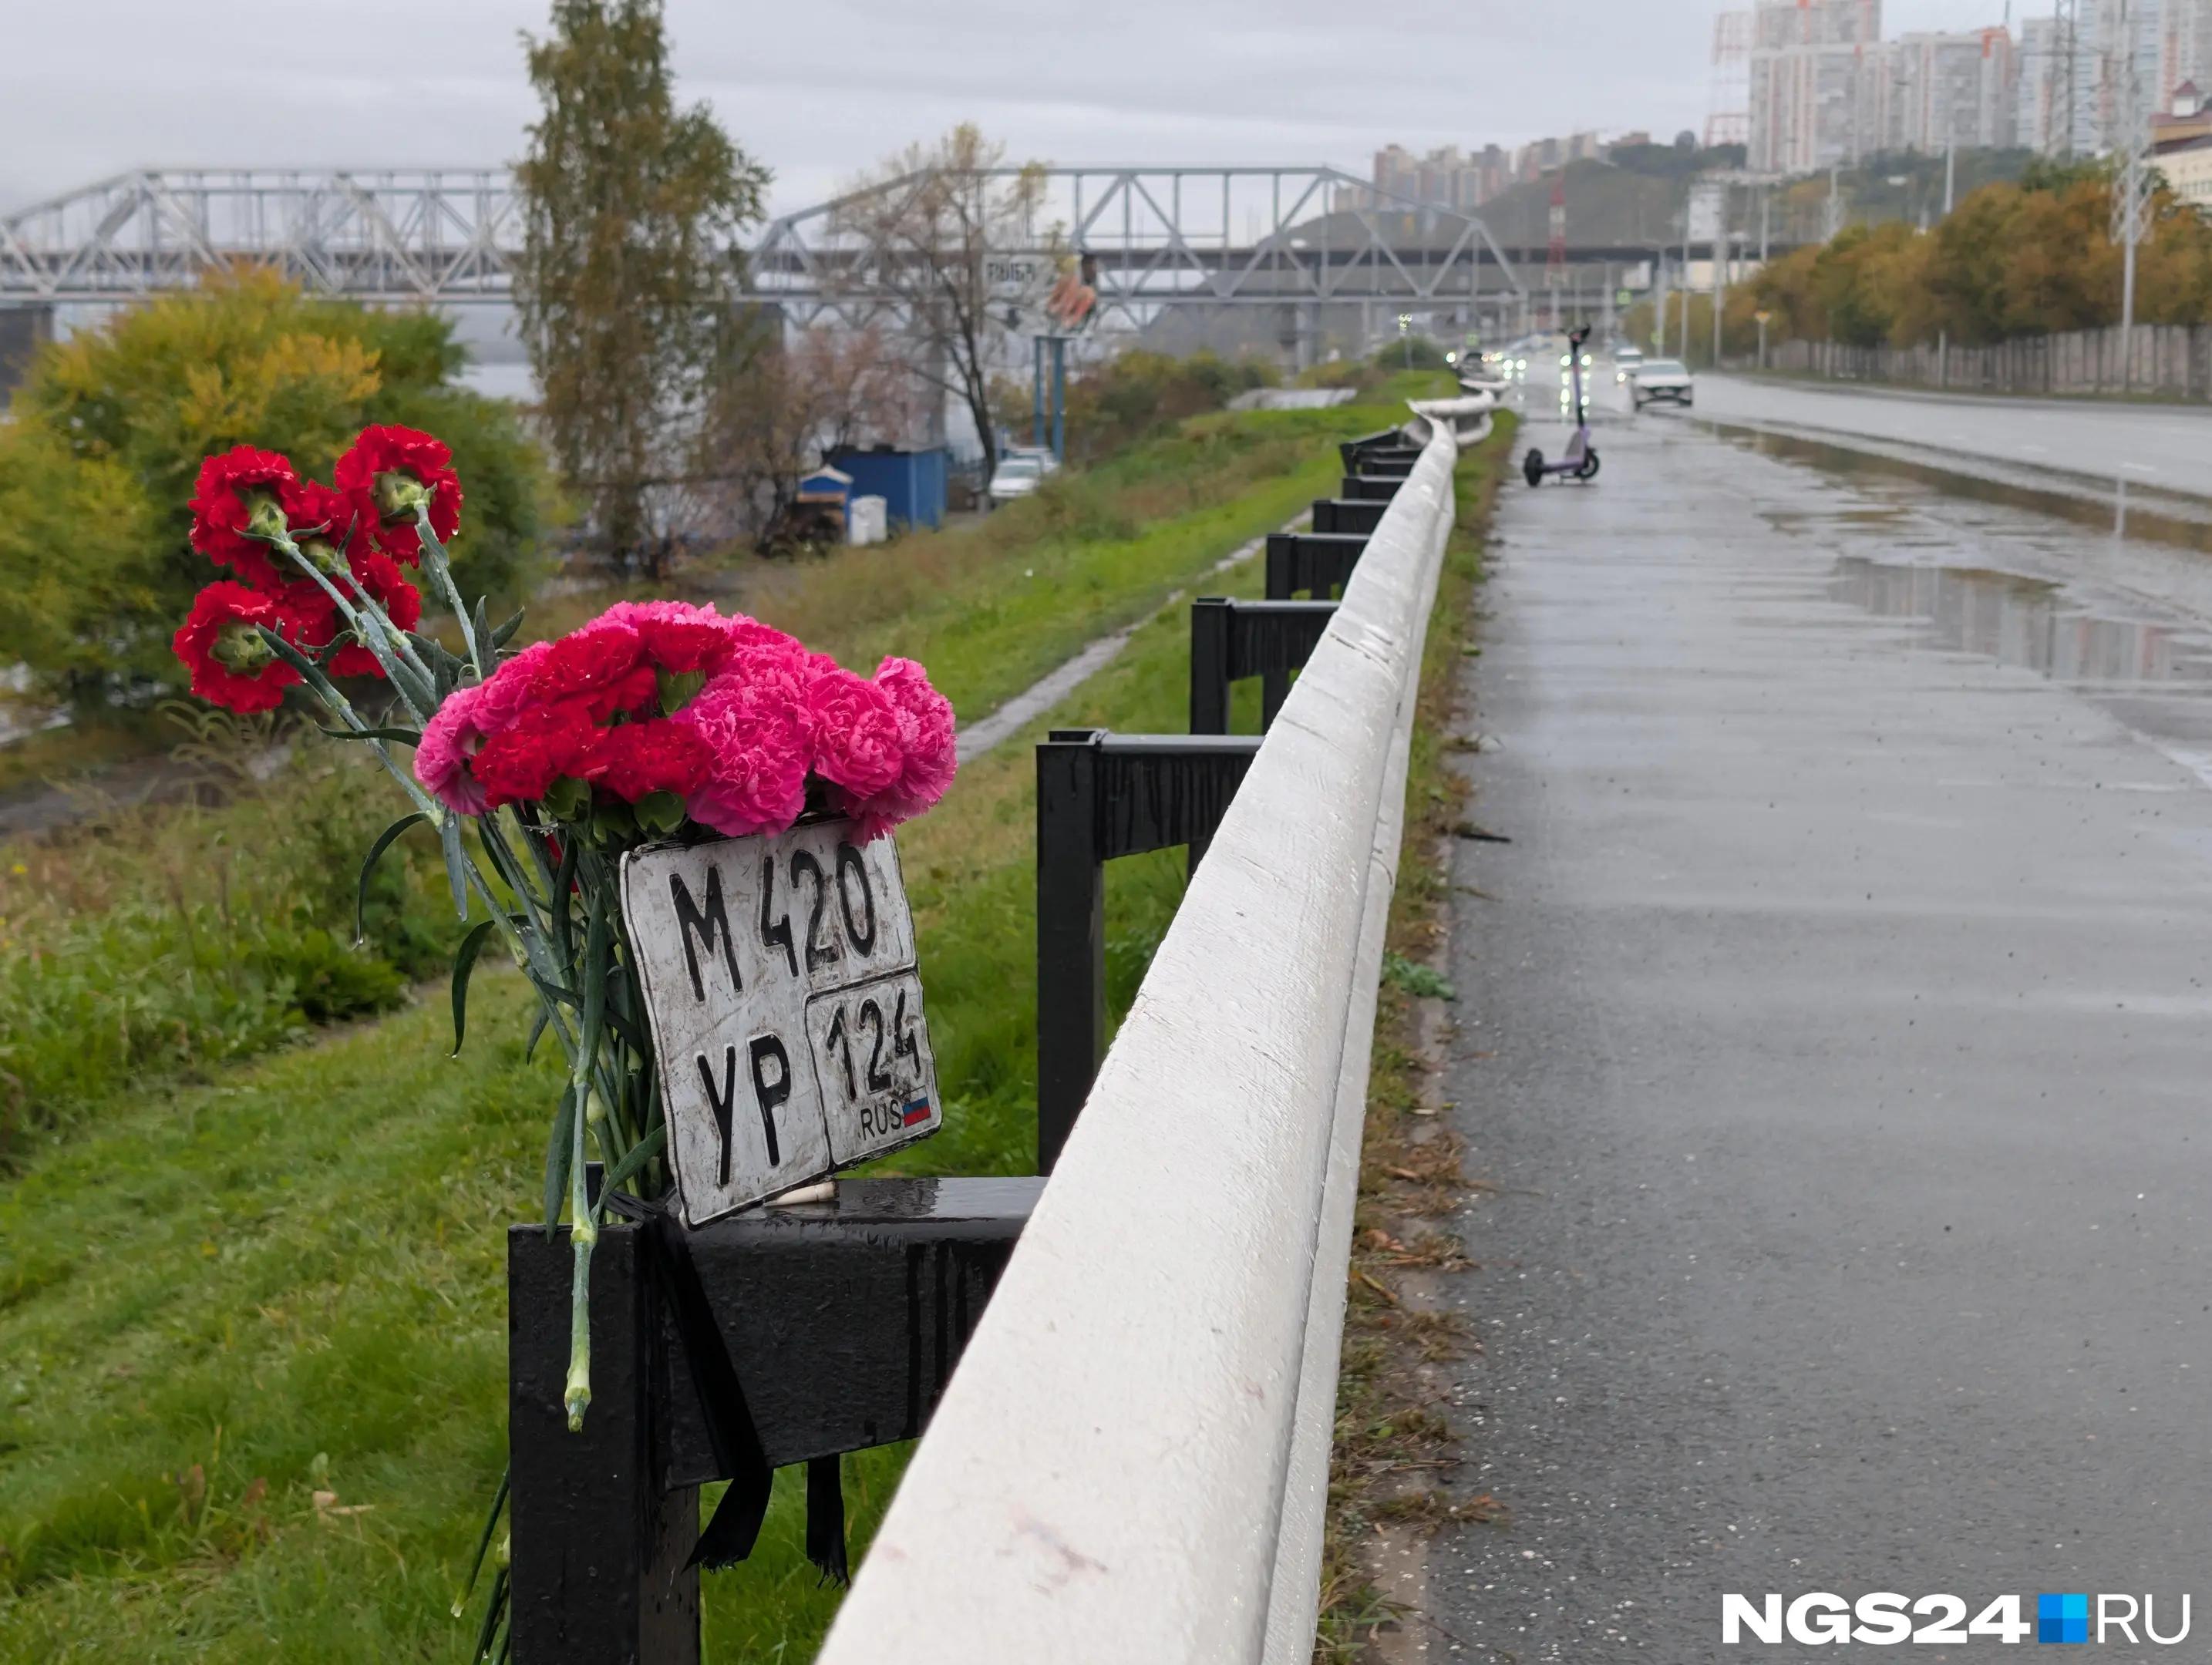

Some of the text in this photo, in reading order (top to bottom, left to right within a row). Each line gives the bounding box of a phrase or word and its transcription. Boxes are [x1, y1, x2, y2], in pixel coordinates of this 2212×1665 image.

[668, 841, 877, 1002] М 420
[697, 1034, 791, 1186] УР
[827, 987, 921, 1101] 124
[860, 1099, 902, 1141] RUS
